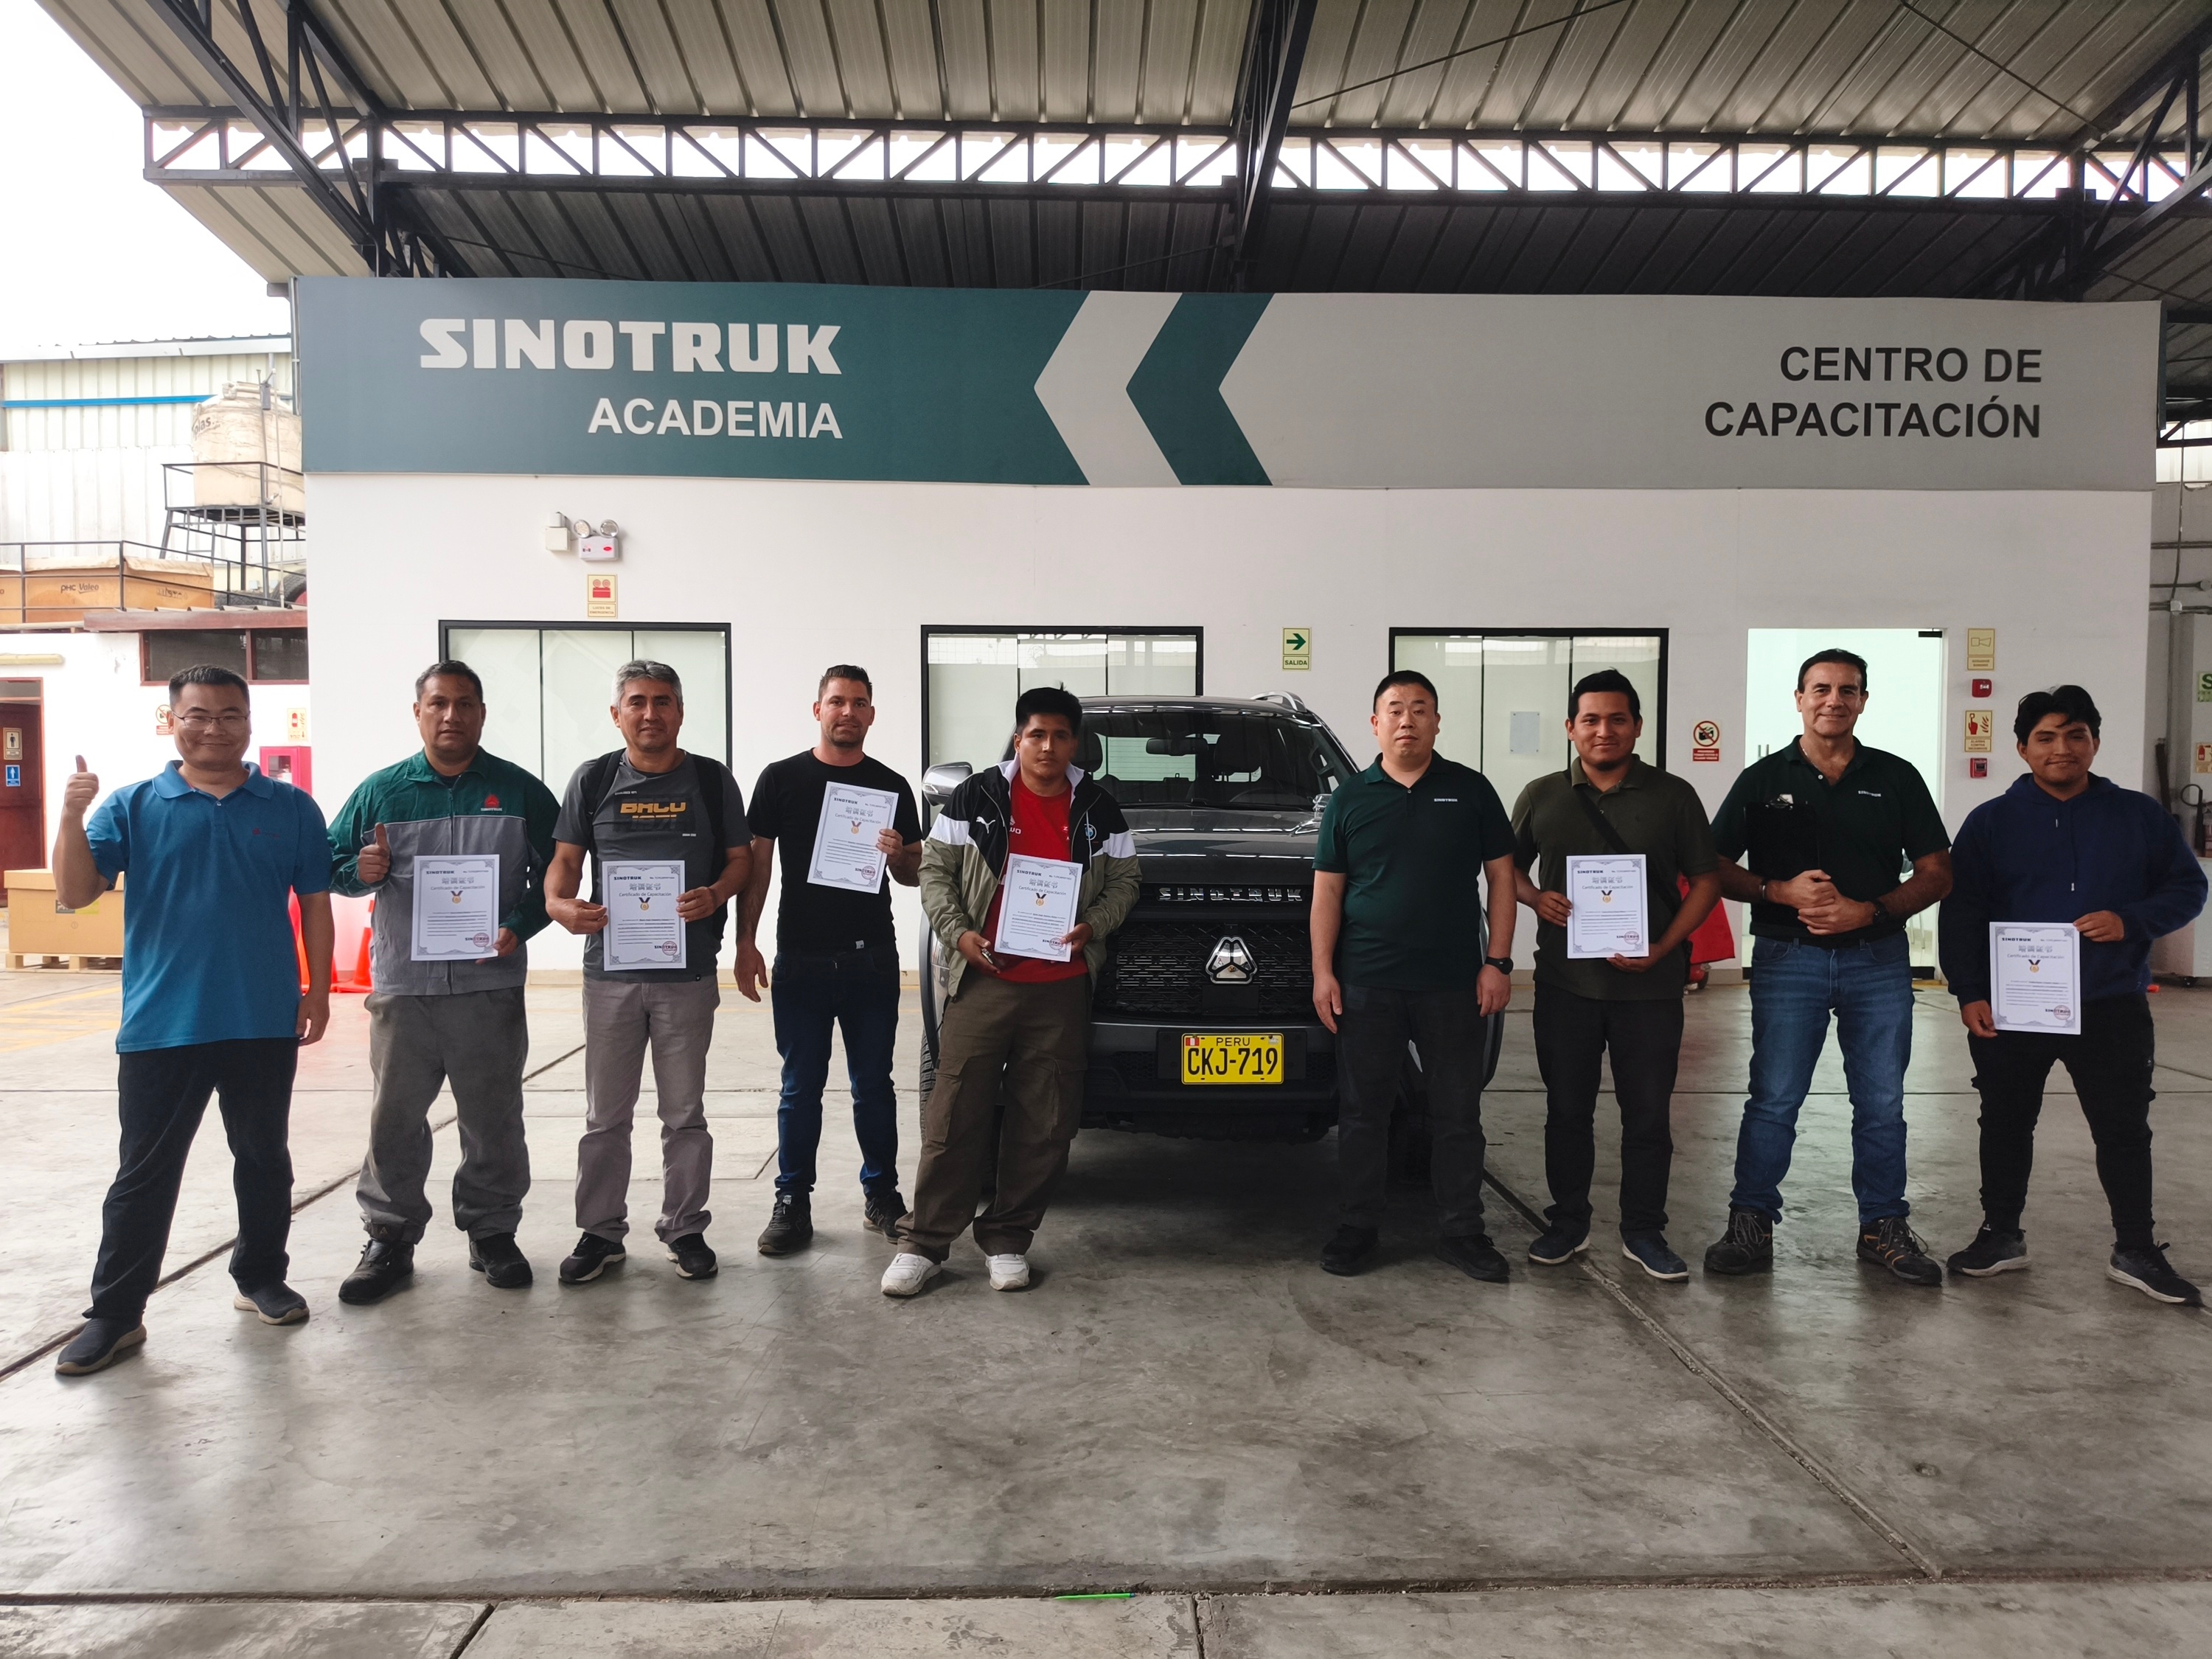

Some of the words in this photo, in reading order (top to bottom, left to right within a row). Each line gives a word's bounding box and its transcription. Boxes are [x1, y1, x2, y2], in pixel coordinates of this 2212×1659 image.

[420, 319, 842, 375] SINOTRUK
[1780, 347, 1969, 382] CENTRO
[1984, 349, 2042, 383] DE
[588, 397, 843, 439] ACADEMIA
[1705, 395, 2040, 438] CAPACITACIÓN
[1158, 887, 1303, 902] SINOTRUK
[1217, 1037, 1251, 1046] PERU
[1188, 1048, 1278, 1075] CKJ-719
